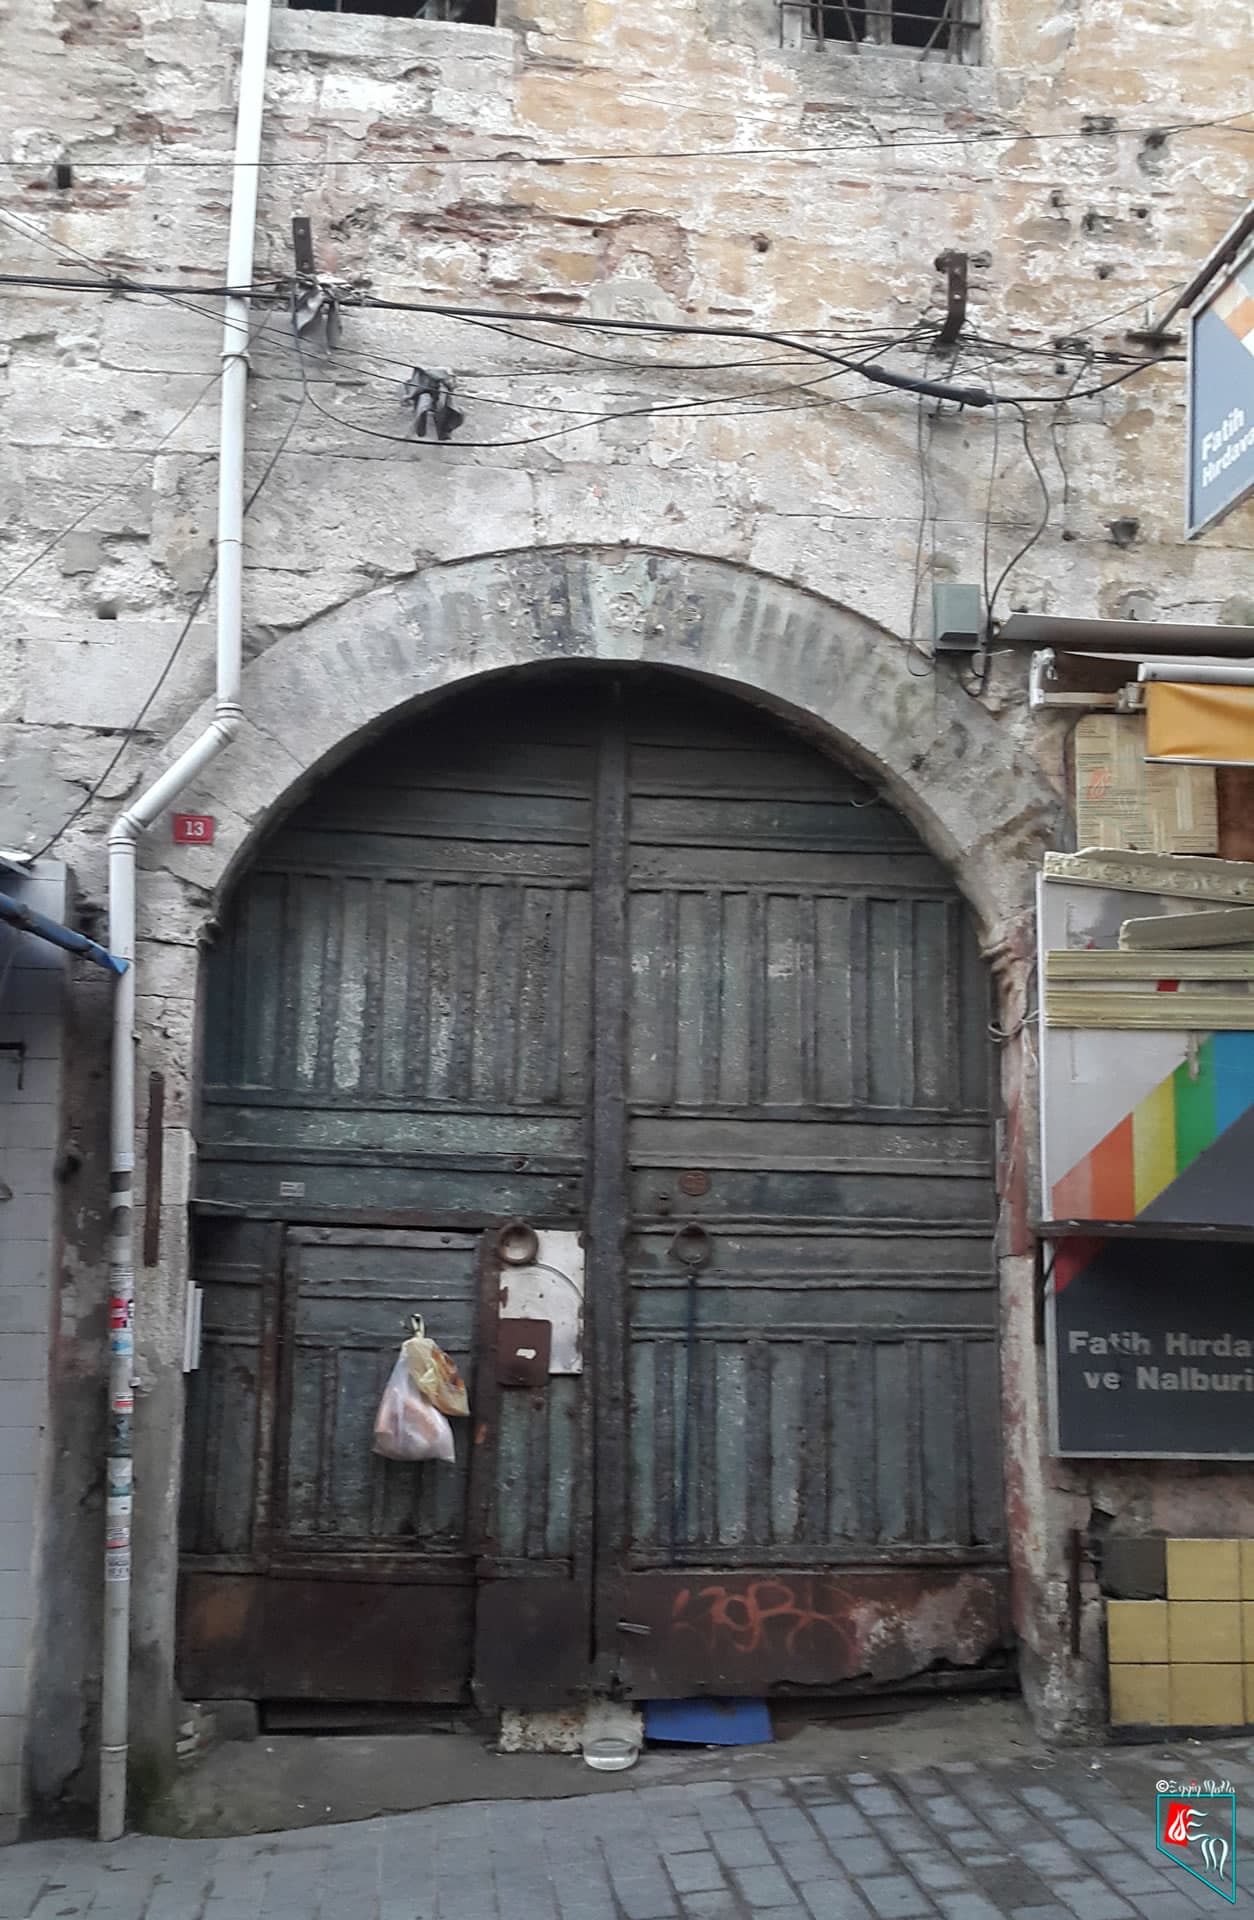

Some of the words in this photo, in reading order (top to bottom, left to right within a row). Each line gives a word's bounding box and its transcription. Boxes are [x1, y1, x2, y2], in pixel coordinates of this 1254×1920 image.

[1202, 407, 1245, 461] Fatih
[184, 820, 205, 836] 13
[1068, 1330, 1151, 1354] Fatih
[1165, 1332, 1254, 1357] Hırda
[1083, 1371, 1121, 1390] ve
